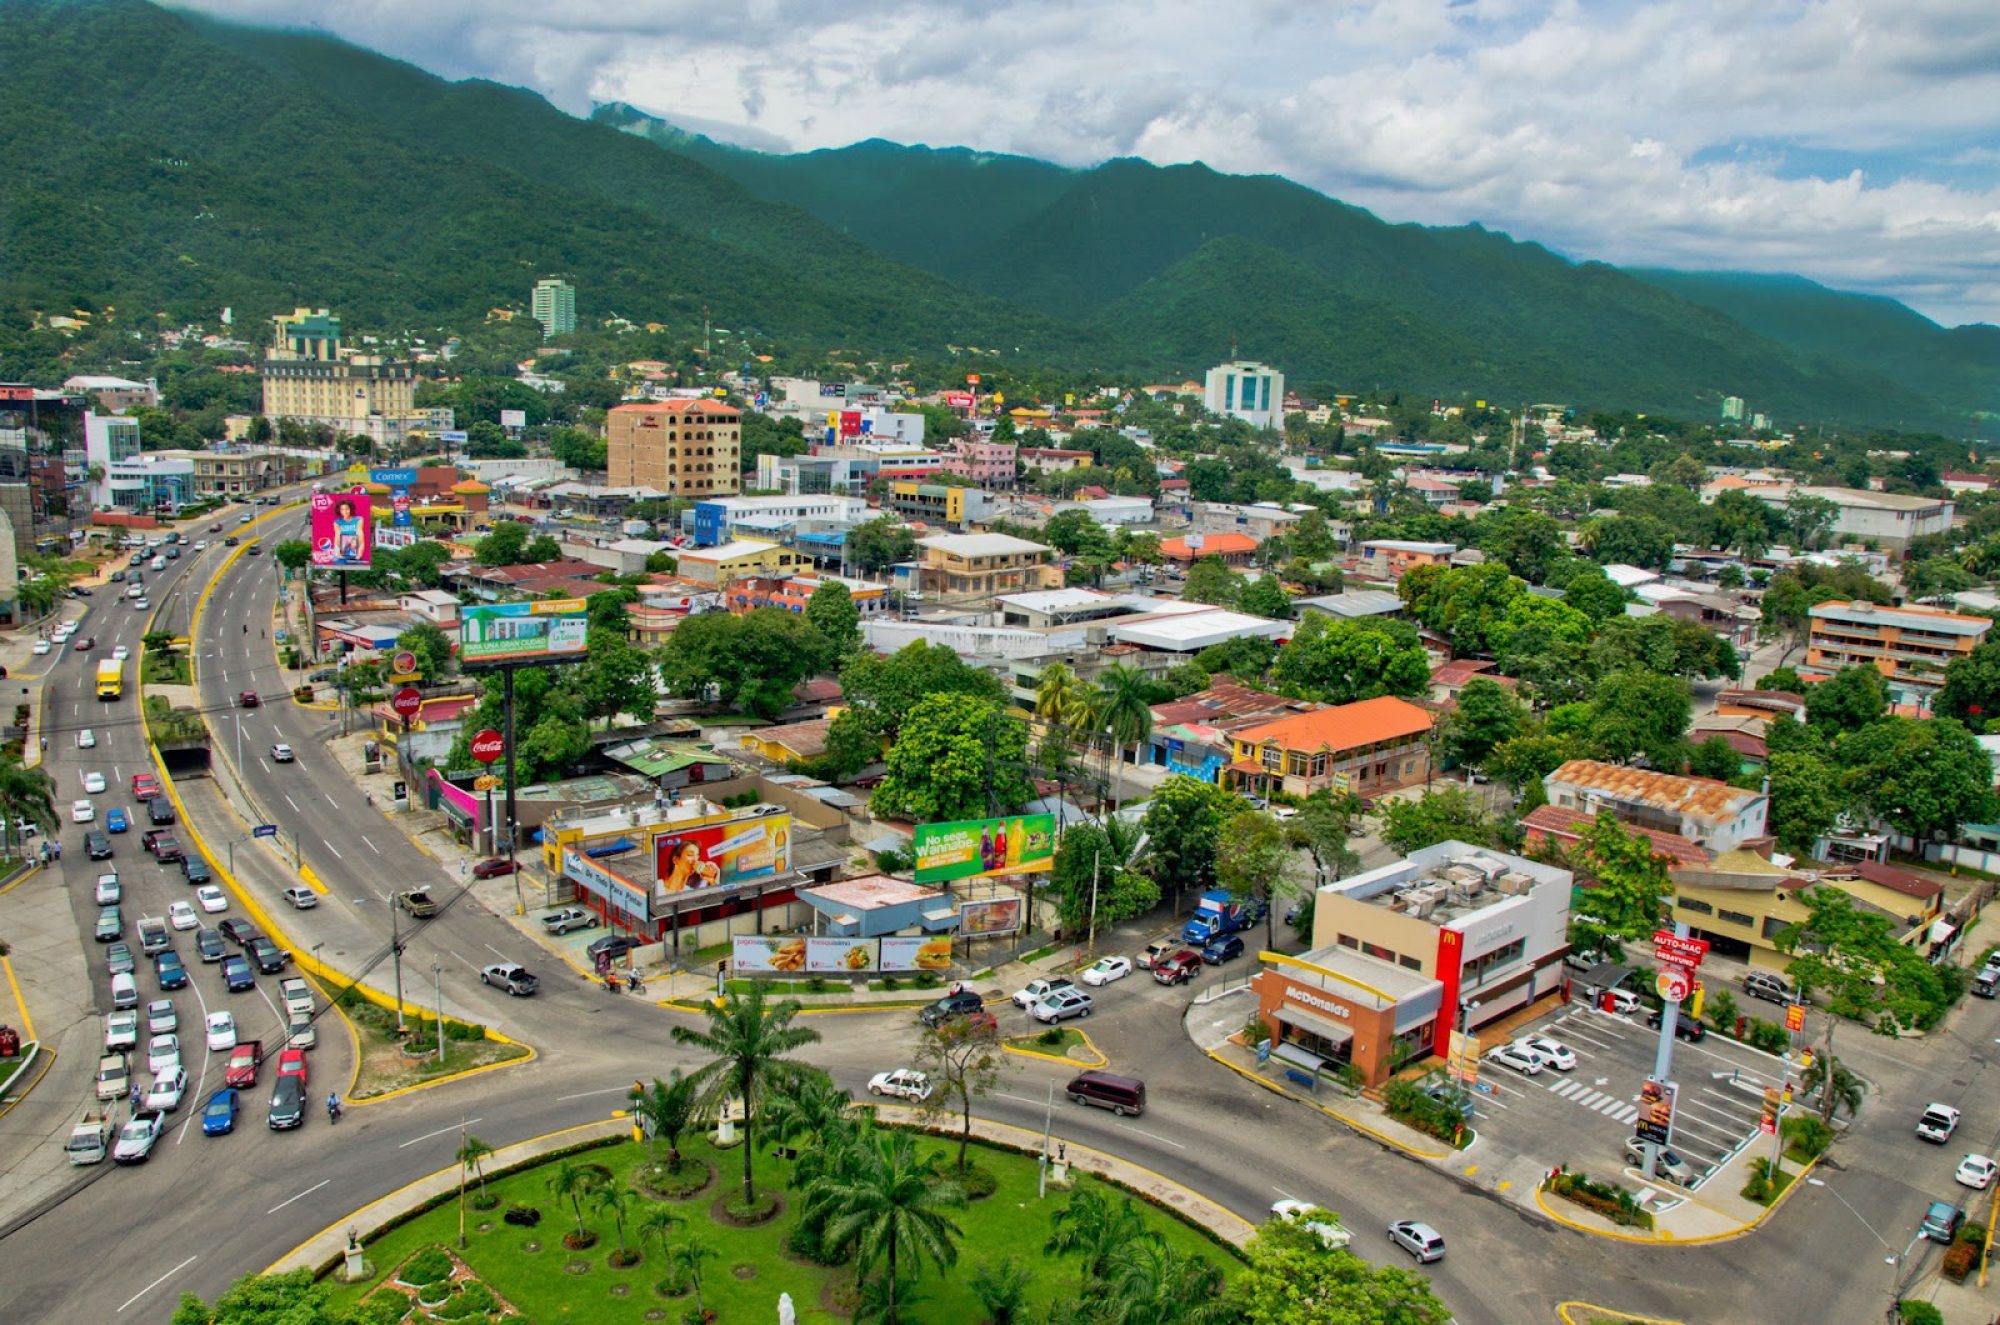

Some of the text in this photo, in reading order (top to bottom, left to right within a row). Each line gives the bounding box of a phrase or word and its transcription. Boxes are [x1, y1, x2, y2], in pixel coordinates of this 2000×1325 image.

[375, 472, 407, 481] Comex
[394, 696, 420, 708] Coca-Cola
[473, 740, 503, 753] Coca-Cola
[925, 835, 941, 846] No
[1653, 935, 1702, 954] AUTO-MAC
[1285, 985, 1350, 1019] McDonald's
